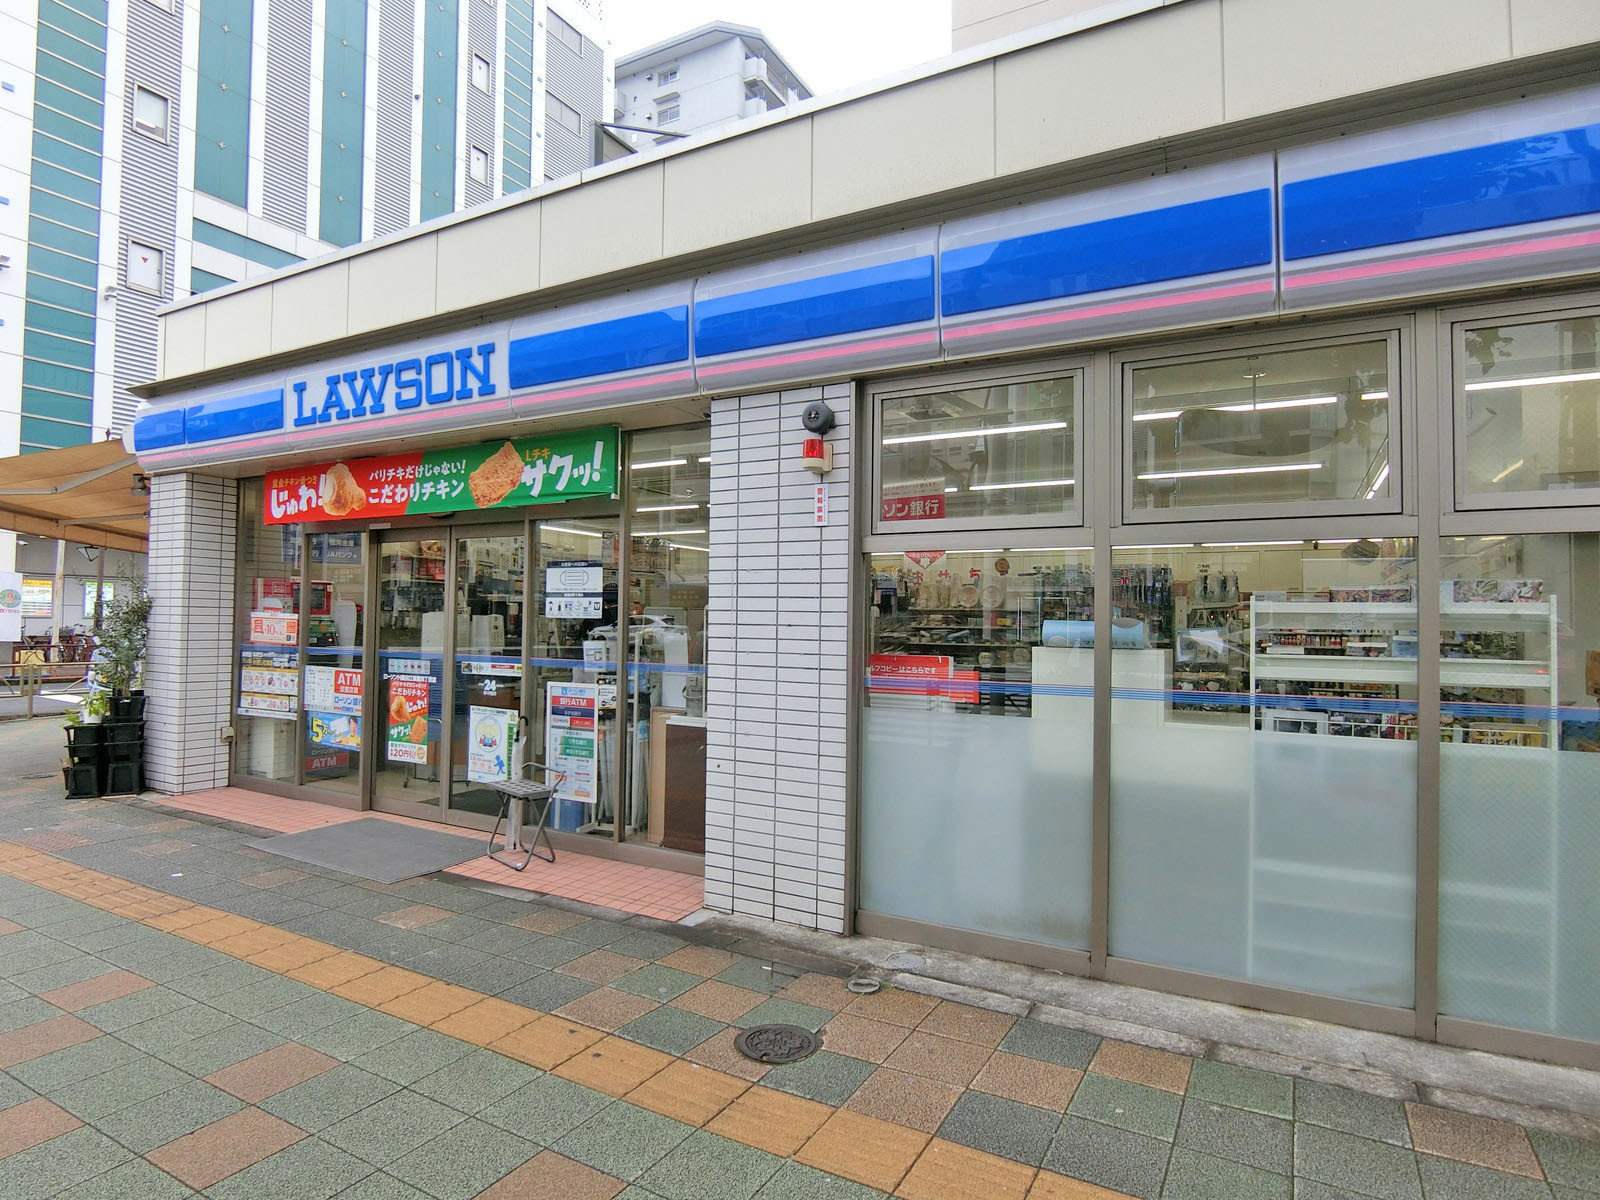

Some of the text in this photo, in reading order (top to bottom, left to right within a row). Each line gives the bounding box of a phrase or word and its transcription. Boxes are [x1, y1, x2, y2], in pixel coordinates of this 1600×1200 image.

[293, 342, 496, 427] LAWSON
[525, 447, 551, 462] Lチキ
[369, 459, 466, 481] パリチキだけじゃない!
[520, 440, 605, 498] サクッ!
[368, 479, 465, 504] こだわりチキン
[881, 499, 939, 518] ソン銀行
[337, 673, 361, 686] ATM
[483, 679, 497, 691] 24
[392, 687, 427, 698] こだわりチキン
[311, 756, 337, 769] ATM
